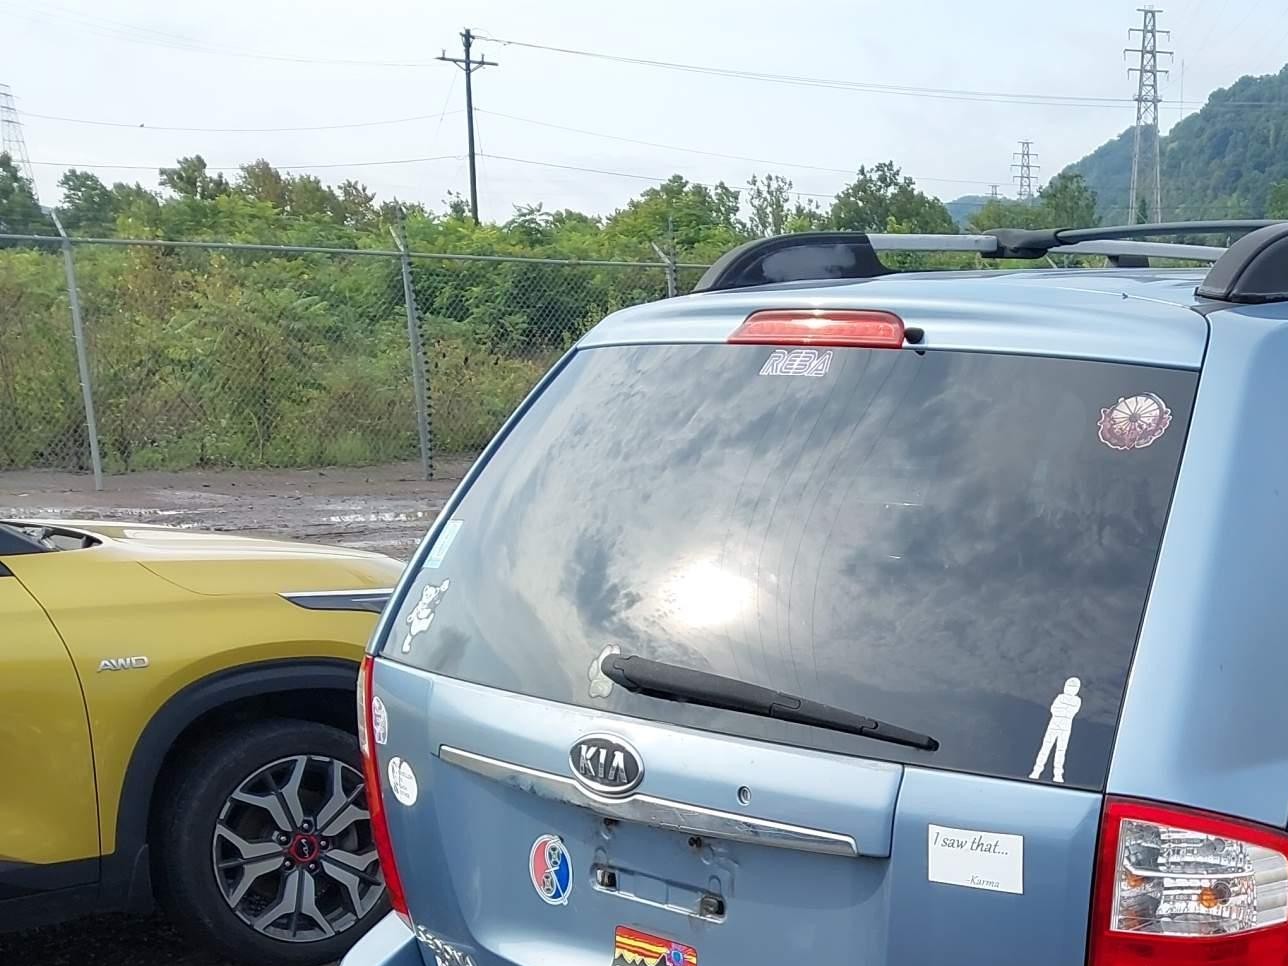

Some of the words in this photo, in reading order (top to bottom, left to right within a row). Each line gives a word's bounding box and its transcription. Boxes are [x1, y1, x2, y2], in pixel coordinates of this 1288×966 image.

[759, 349, 833, 377] REBA
[97, 656, 149, 672] AWD
[579, 744, 628, 784] KIA
[933, 831, 940, 847] I
[940, 837, 968, 850] saw
[969, 834, 1009, 856] that...
